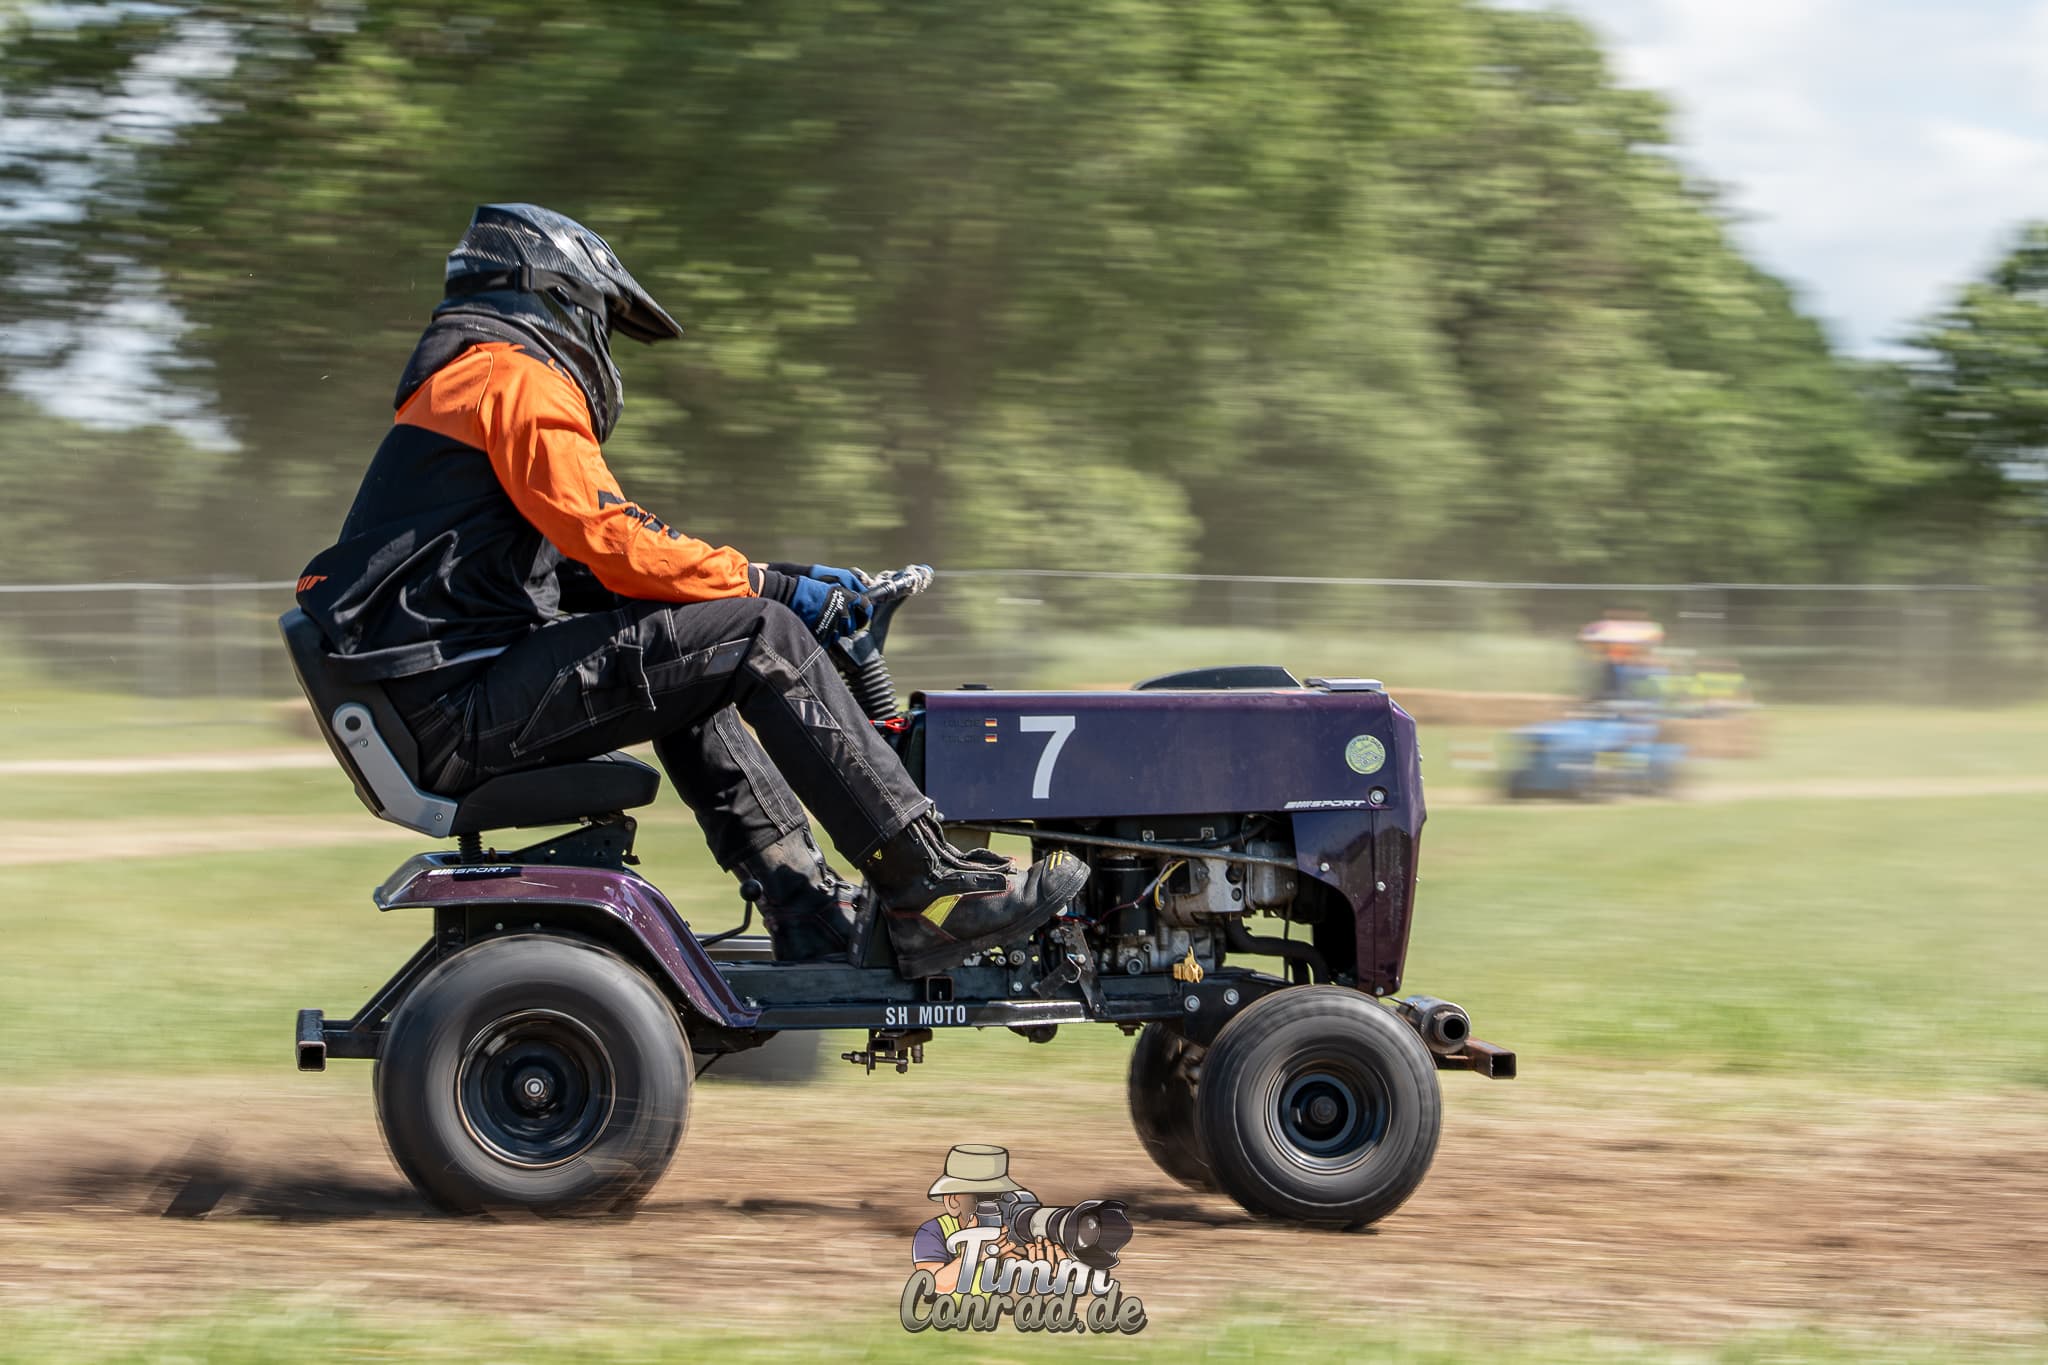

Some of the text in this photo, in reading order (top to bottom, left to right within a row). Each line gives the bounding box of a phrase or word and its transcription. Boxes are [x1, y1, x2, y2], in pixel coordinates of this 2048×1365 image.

[1020, 715, 1076, 799] 7
[1311, 799, 1366, 808] SPORT
[454, 866, 512, 875] SPORT
[885, 1004, 966, 1025] SH MOTO
